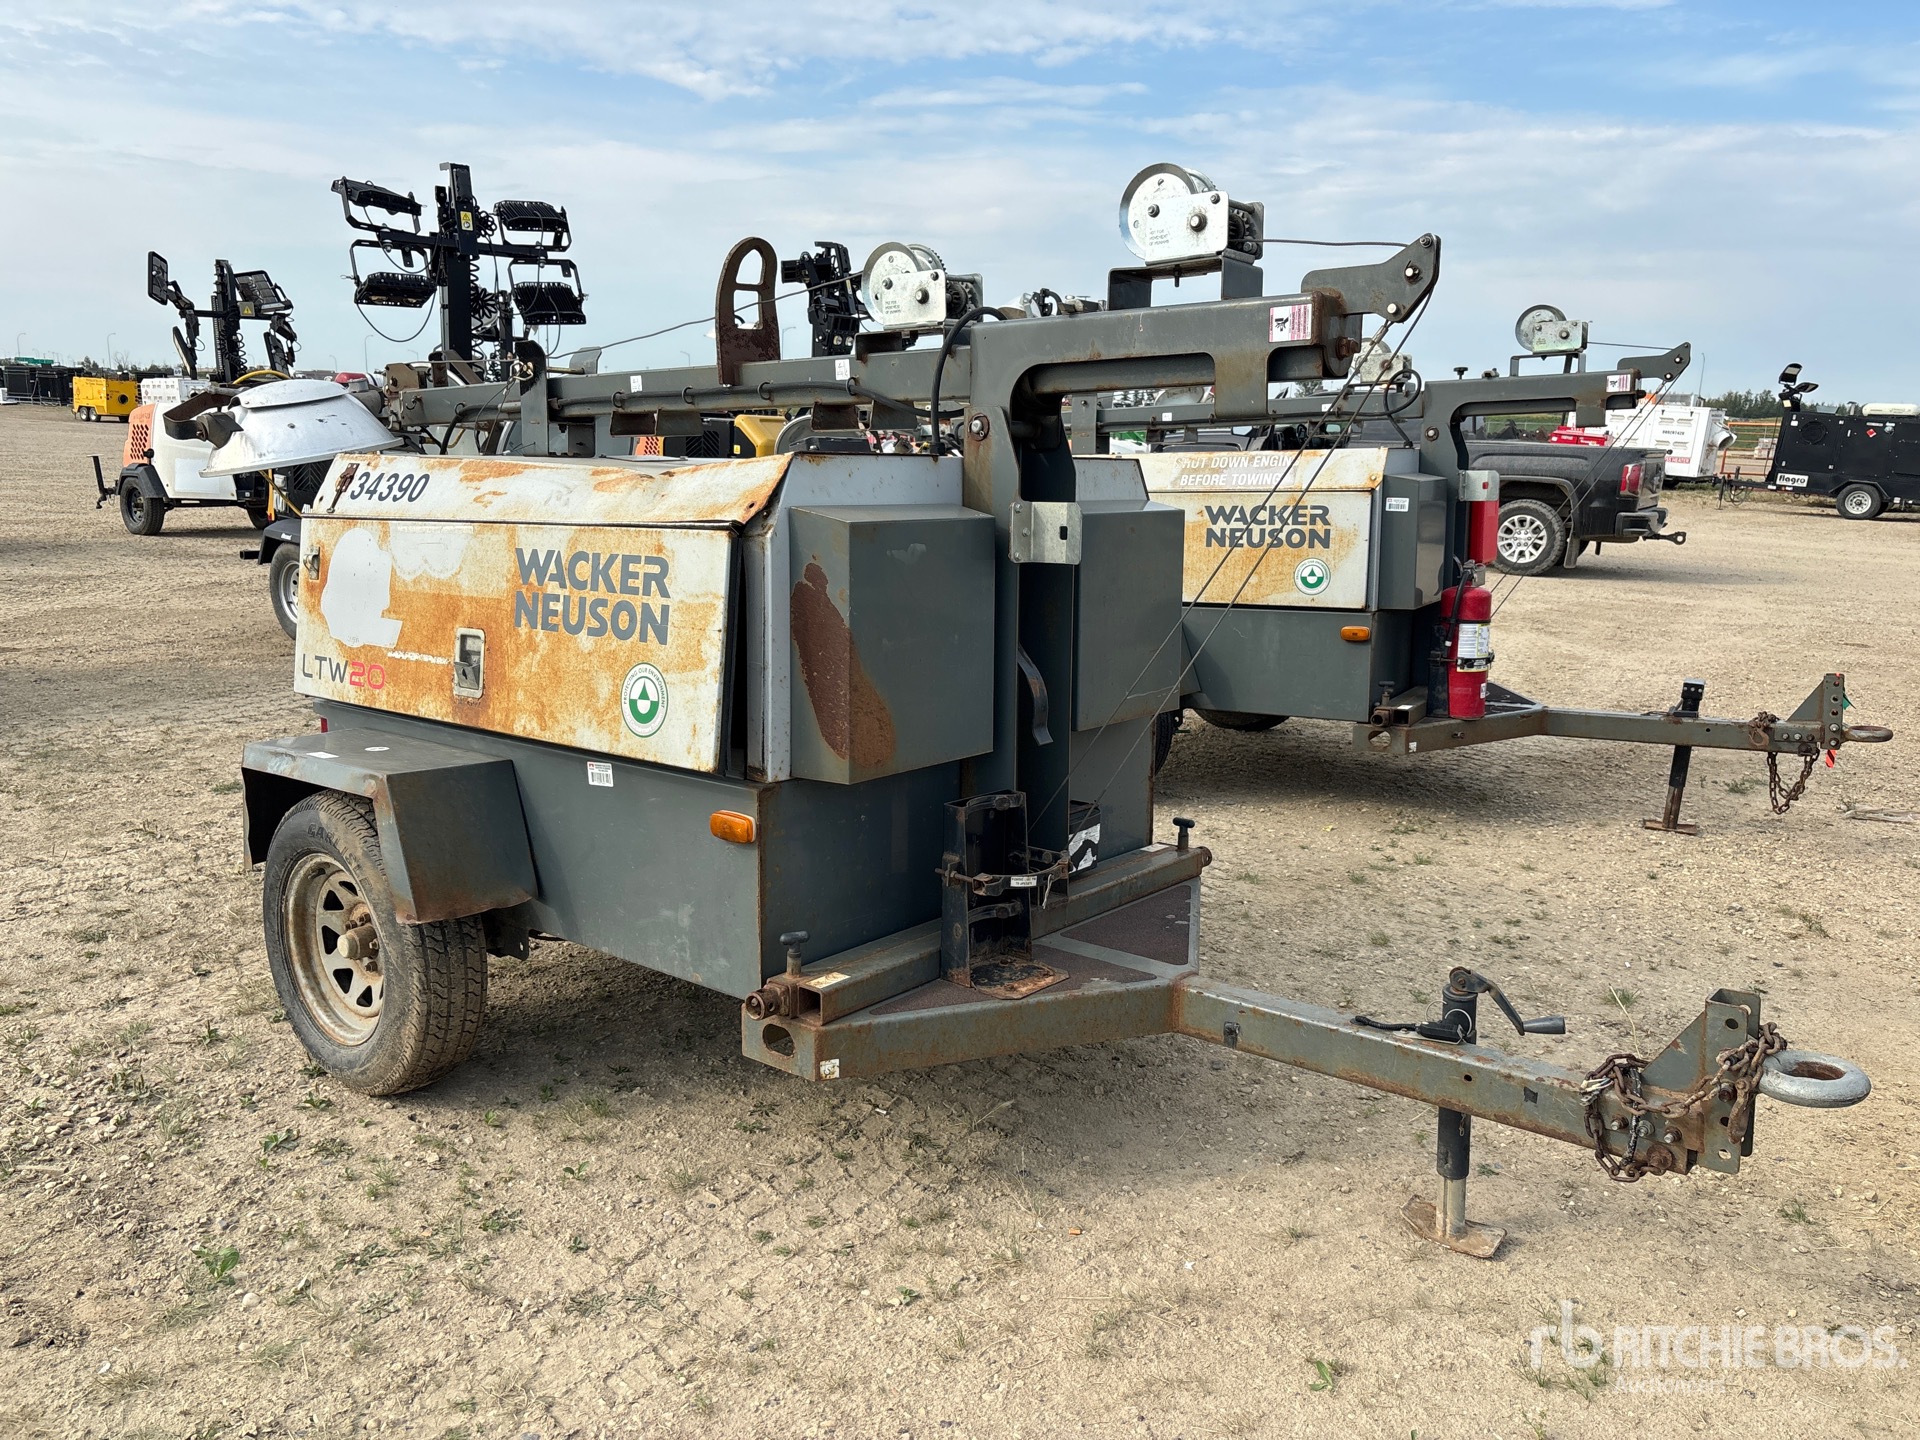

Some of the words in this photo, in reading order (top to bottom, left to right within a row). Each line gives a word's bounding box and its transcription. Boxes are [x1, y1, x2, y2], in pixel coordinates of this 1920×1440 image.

[1176, 457, 1208, 469] SHUT
[1210, 456, 1249, 468] DOWN
[350, 471, 430, 502] 34390
[1180, 474, 1227, 486] BEFORE
[1231, 473, 1281, 486] TOWING
[1779, 474, 1806, 484] flagro
[1205, 505, 1331, 526] WACKER
[1205, 527, 1331, 549] NEUSON
[515, 547, 671, 598] WACKER
[514, 591, 669, 646] NEUSON
[302, 653, 386, 690] LTW20
[623, 671, 638, 704] PROTECTING
[647, 668, 666, 709] ENVIRONMENT
